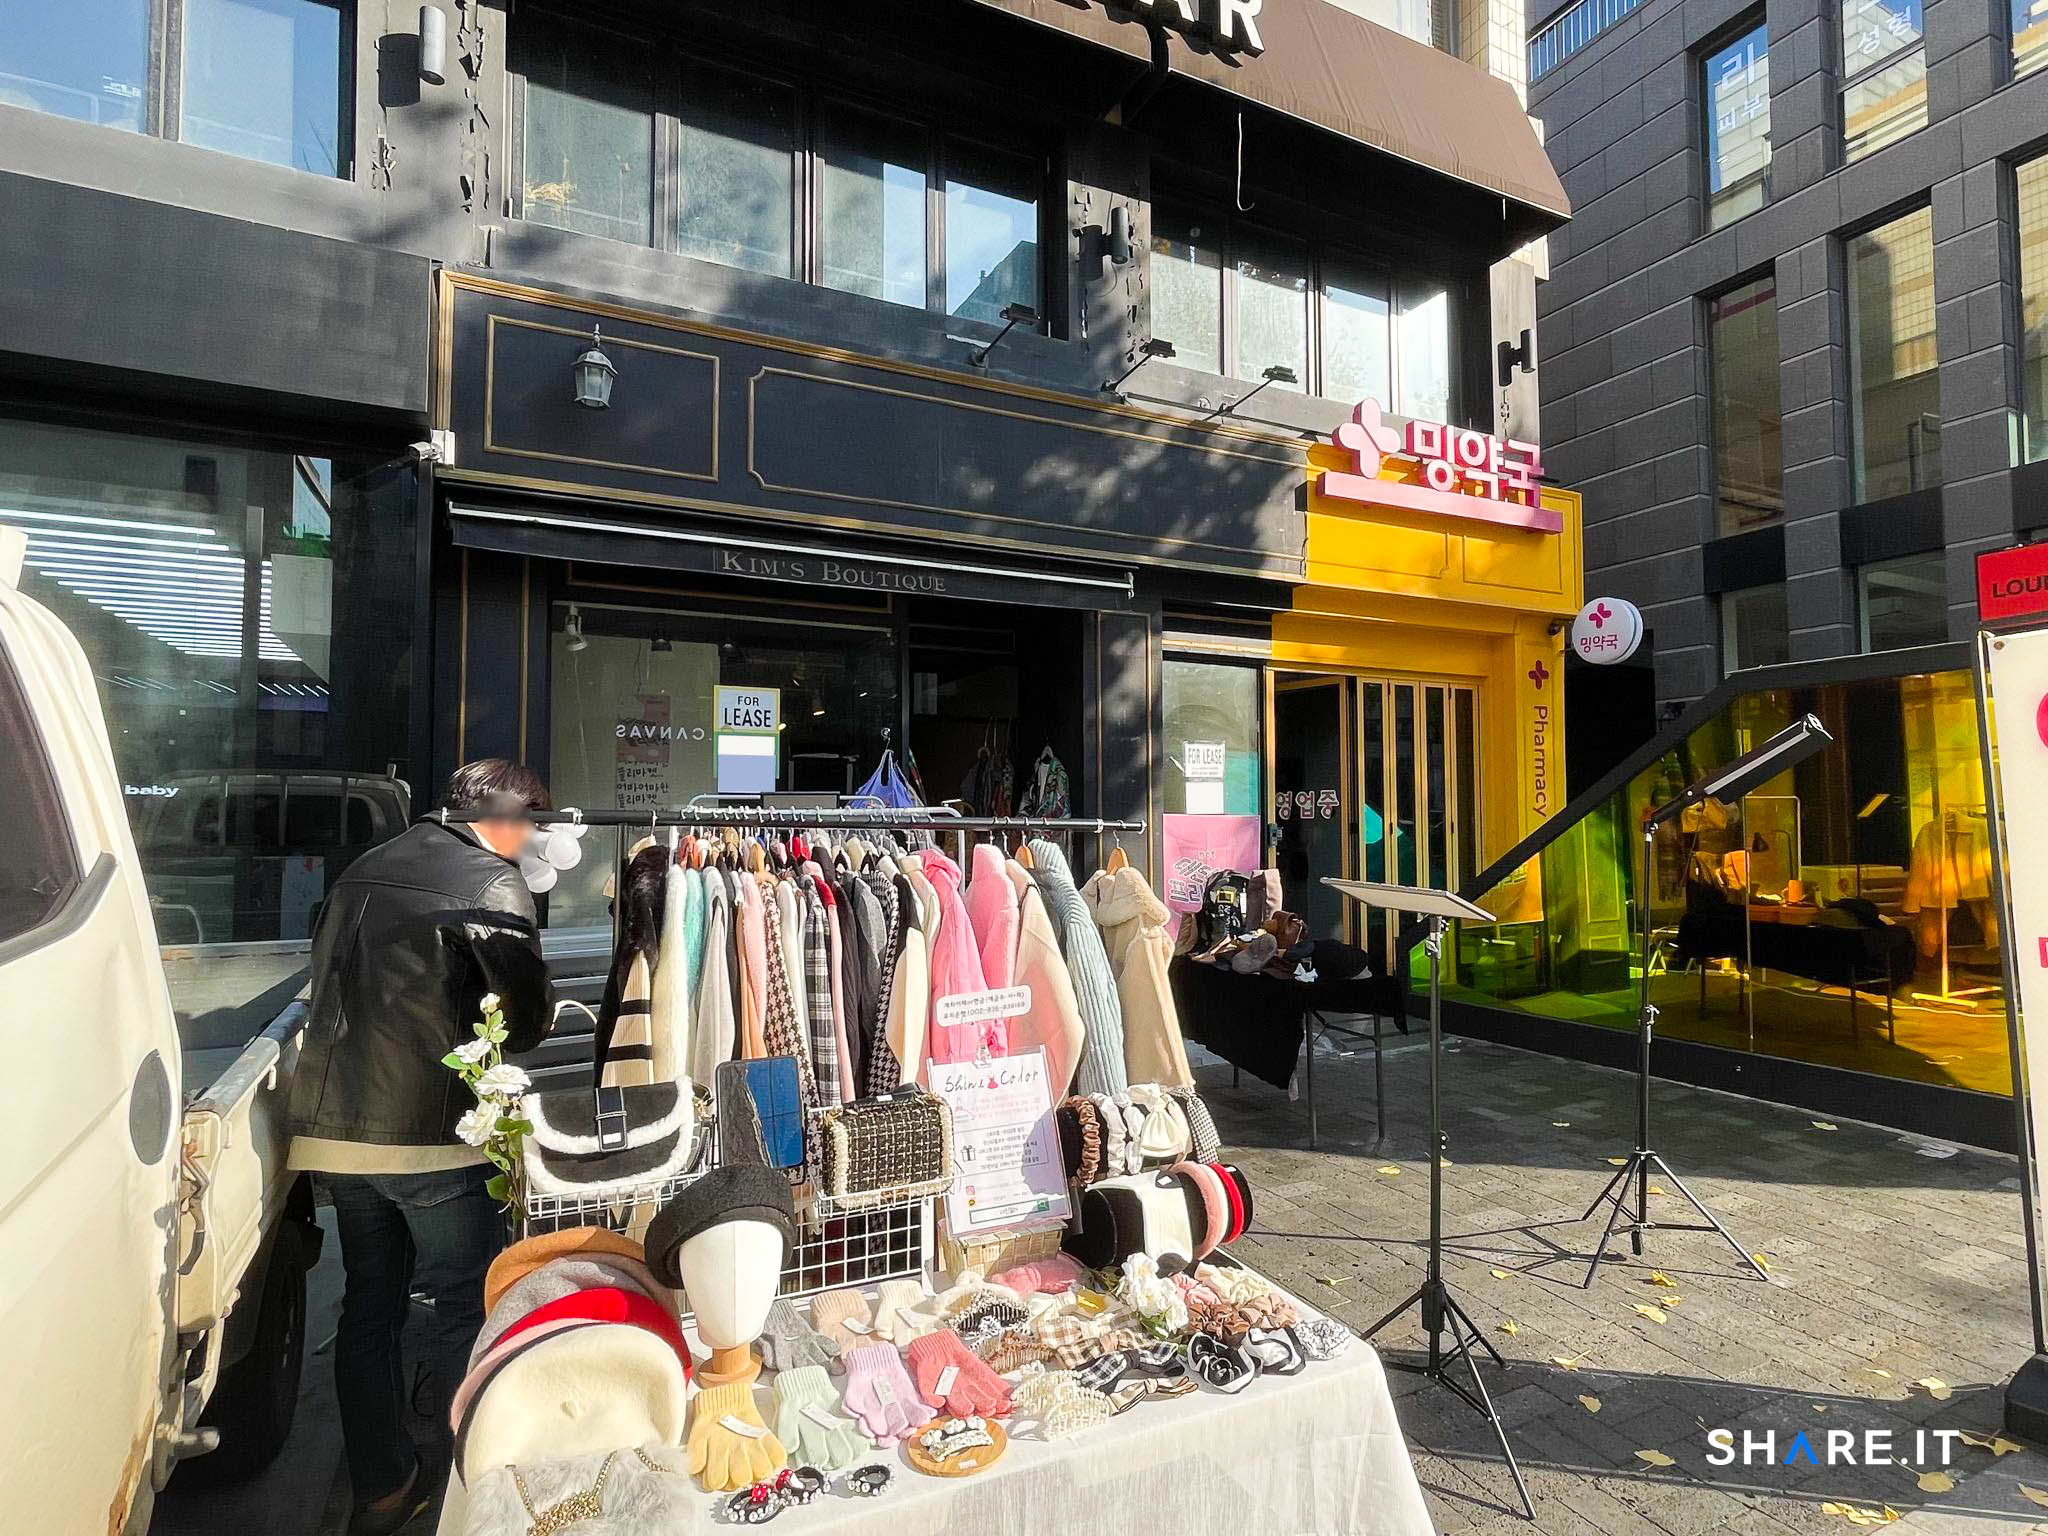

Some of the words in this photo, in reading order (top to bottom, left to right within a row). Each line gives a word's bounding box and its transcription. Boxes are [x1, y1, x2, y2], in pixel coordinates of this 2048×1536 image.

[1406, 420, 1544, 509] 밍약국
[722, 550, 805, 578] KIM'S
[822, 561, 947, 592] BOUTIQUE
[1992, 575, 2048, 598] LOU
[1580, 634, 1618, 653] 밍약국
[737, 696, 759, 707] FOR
[724, 708, 772, 728] LEASE
[1188, 748, 1200, 764] FOR
[1203, 749, 1222, 765] LEASE
[1533, 705, 1548, 818] Pharmacy
[125, 785, 179, 797] baby
[1275, 790, 1340, 820] 영업중
[1000, 1065, 1039, 1086] Color
